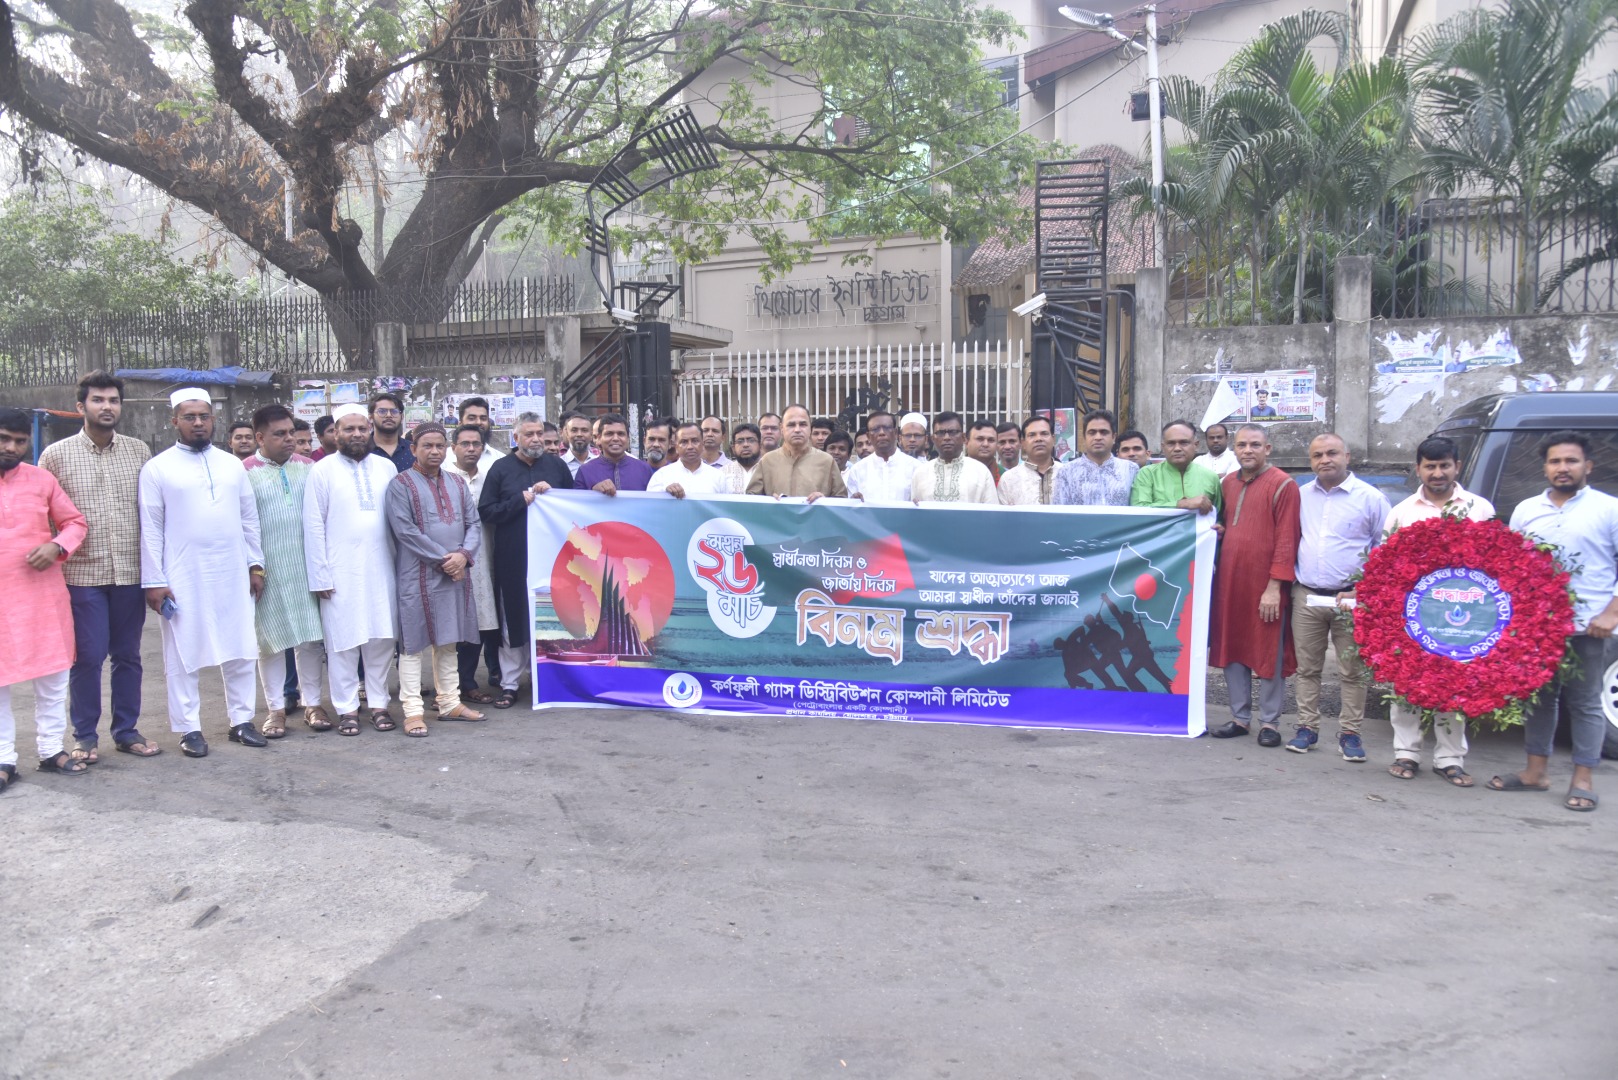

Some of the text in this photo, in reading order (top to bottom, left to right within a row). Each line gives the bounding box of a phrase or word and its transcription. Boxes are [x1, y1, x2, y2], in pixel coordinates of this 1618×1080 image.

[754, 284, 821, 319] থিয়েটার
[863, 304, 906, 323] চট্টগ্রাম
[707, 533, 746, 556] মহান
[694, 539, 760, 595] ২৬
[771, 544, 868, 570] স্বাধীনতা দিবস ও
[821, 569, 897, 593] জাতীয় দিবস
[929, 570, 1071, 588] যাদের আত্মত্যাগে আজ
[1454, 567, 1466, 577] ও
[716, 580, 766, 629] মার্চ
[918, 586, 1080, 609] আমরা স্বাধীন তাঁদের জানাই
[1407, 592, 1421, 617] মহান
[1431, 586, 1487, 605] শ্রদ্ধাঞ্জলি
[795, 588, 1013, 666] বিনম্র শ্রদ্ধা
[1421, 634, 1438, 650] ২৬
[710, 675, 761, 700] কর্ণফুলী
[764, 681, 796, 699] গ্যাস
[798, 680, 883, 704] ডিস্ট্রিবিউশন
[885, 686, 948, 707] কোম্পানী
[950, 687, 1012, 708] লিমিটেড
[845, 703, 868, 712] একটি
